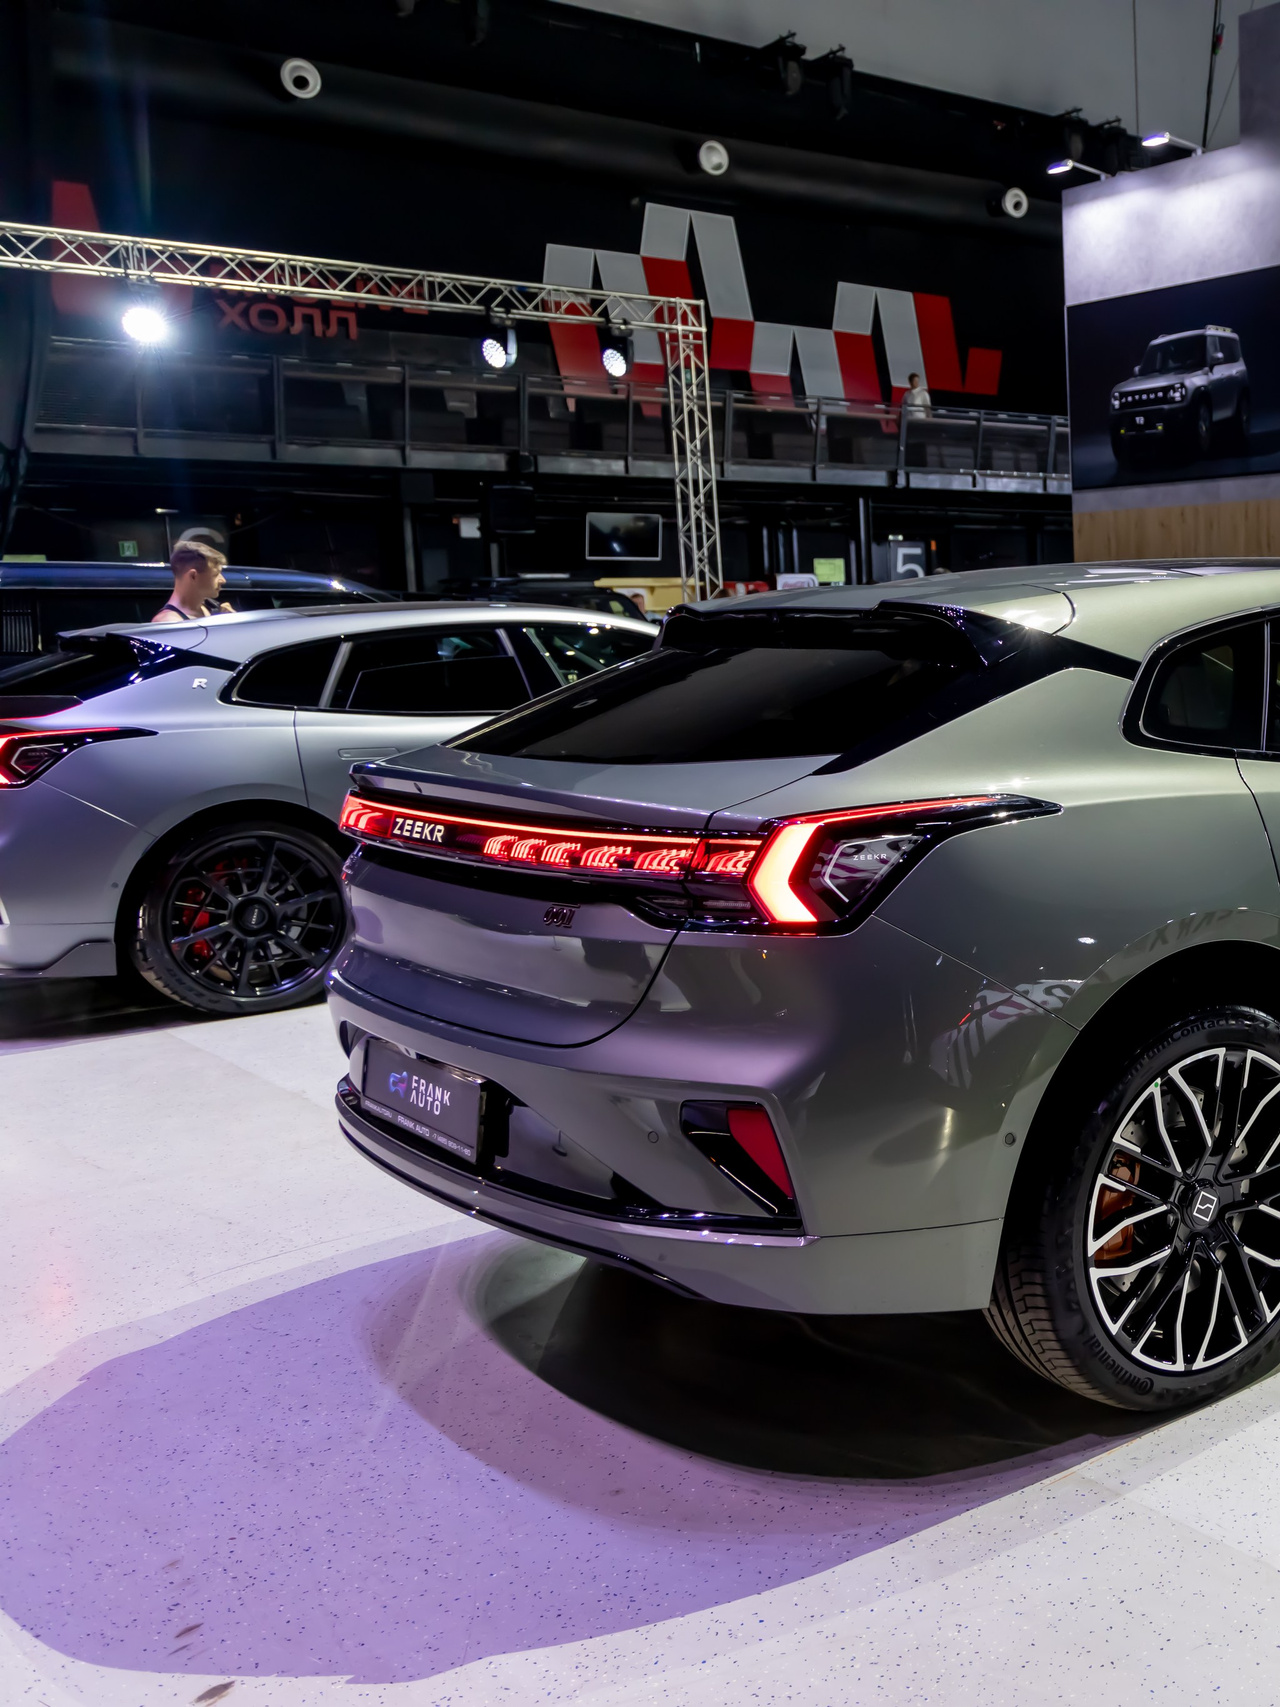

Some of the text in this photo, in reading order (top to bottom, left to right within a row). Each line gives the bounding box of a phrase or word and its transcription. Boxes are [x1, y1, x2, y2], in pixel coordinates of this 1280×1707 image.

[214, 299, 358, 341] ХОЛЛ
[897, 547, 925, 578] 5
[192, 678, 208, 689] R
[393, 817, 445, 843] ZEEKR
[853, 853, 887, 861] ZEEKR
[409, 1089, 441, 1115] AUTO
[411, 1075, 451, 1106] FRANK
[1082, 1334, 1154, 1396] Continental
